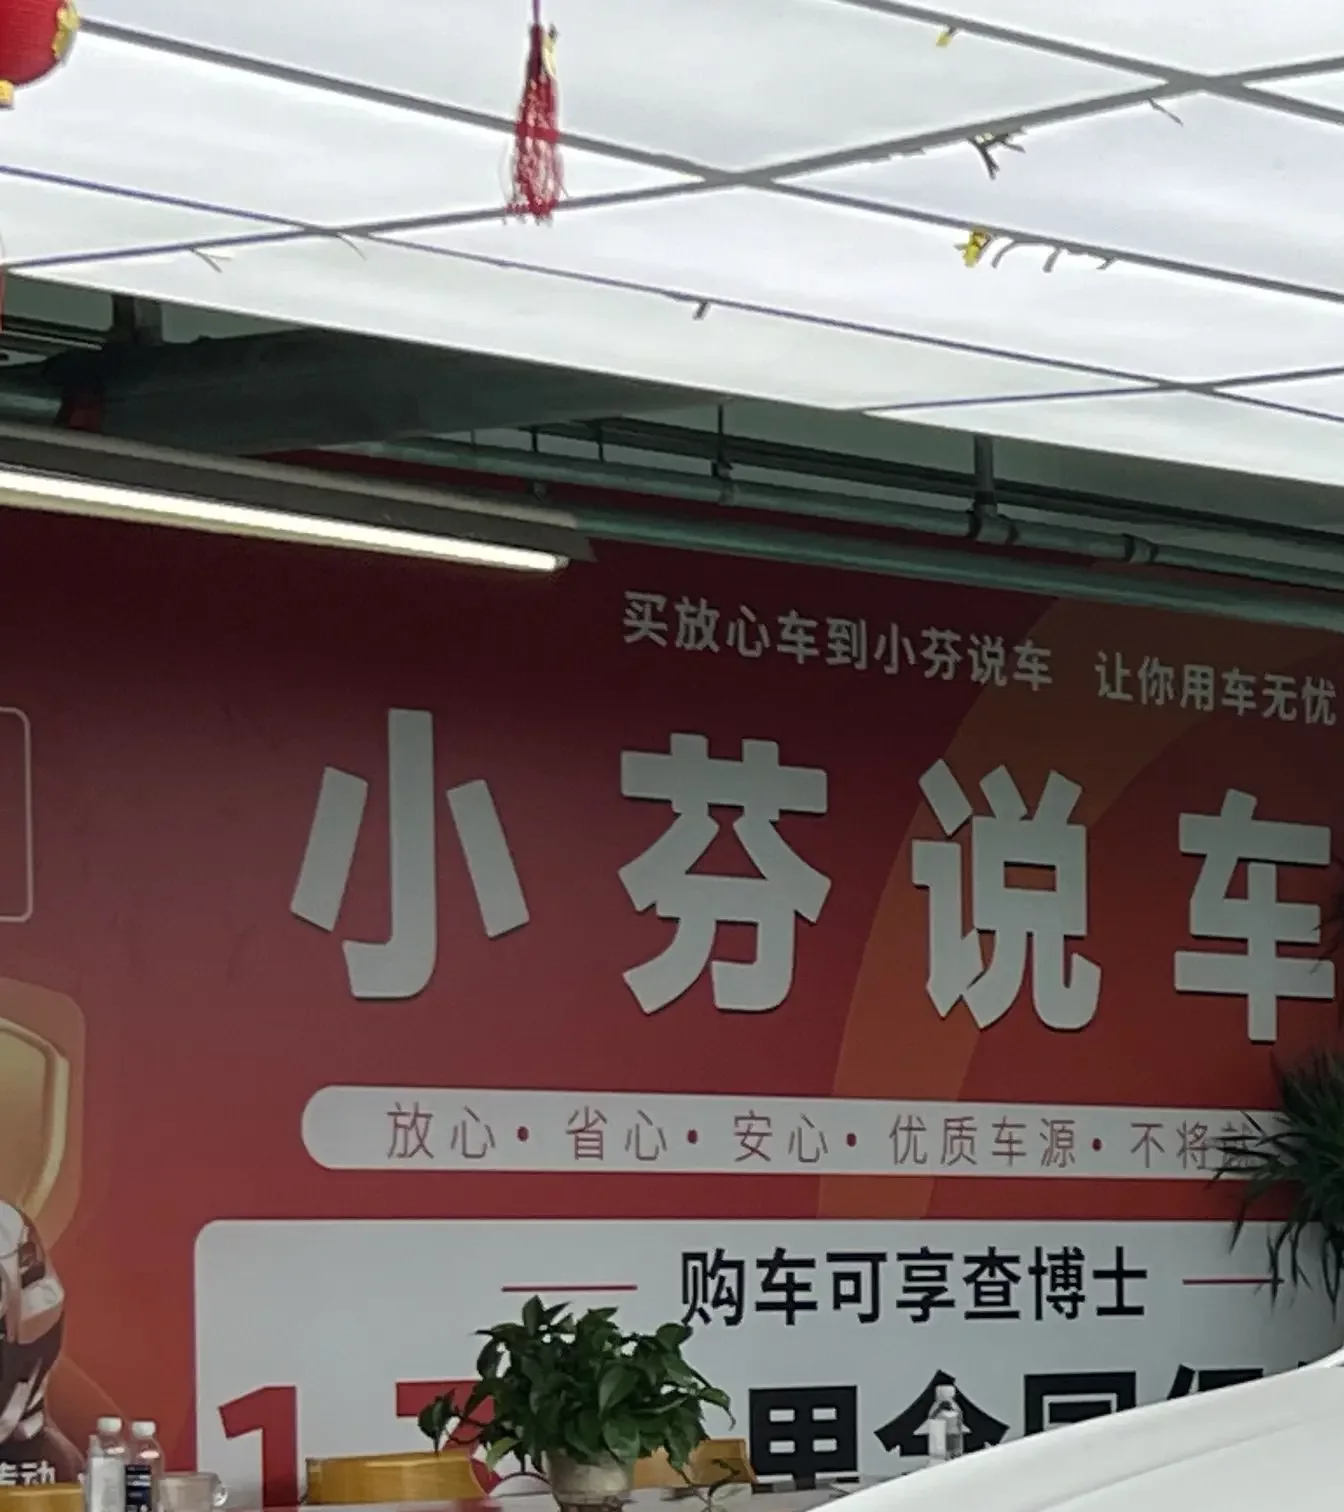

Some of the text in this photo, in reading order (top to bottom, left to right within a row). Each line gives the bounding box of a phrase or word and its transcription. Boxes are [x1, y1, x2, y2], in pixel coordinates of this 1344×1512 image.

[622, 588, 1339, 728] 买放心车到小芬说车 让你用车无忧
[289, 707, 1336, 1042] 小芬说车
[680, 1245, 1149, 1327] 购车可享查博士
